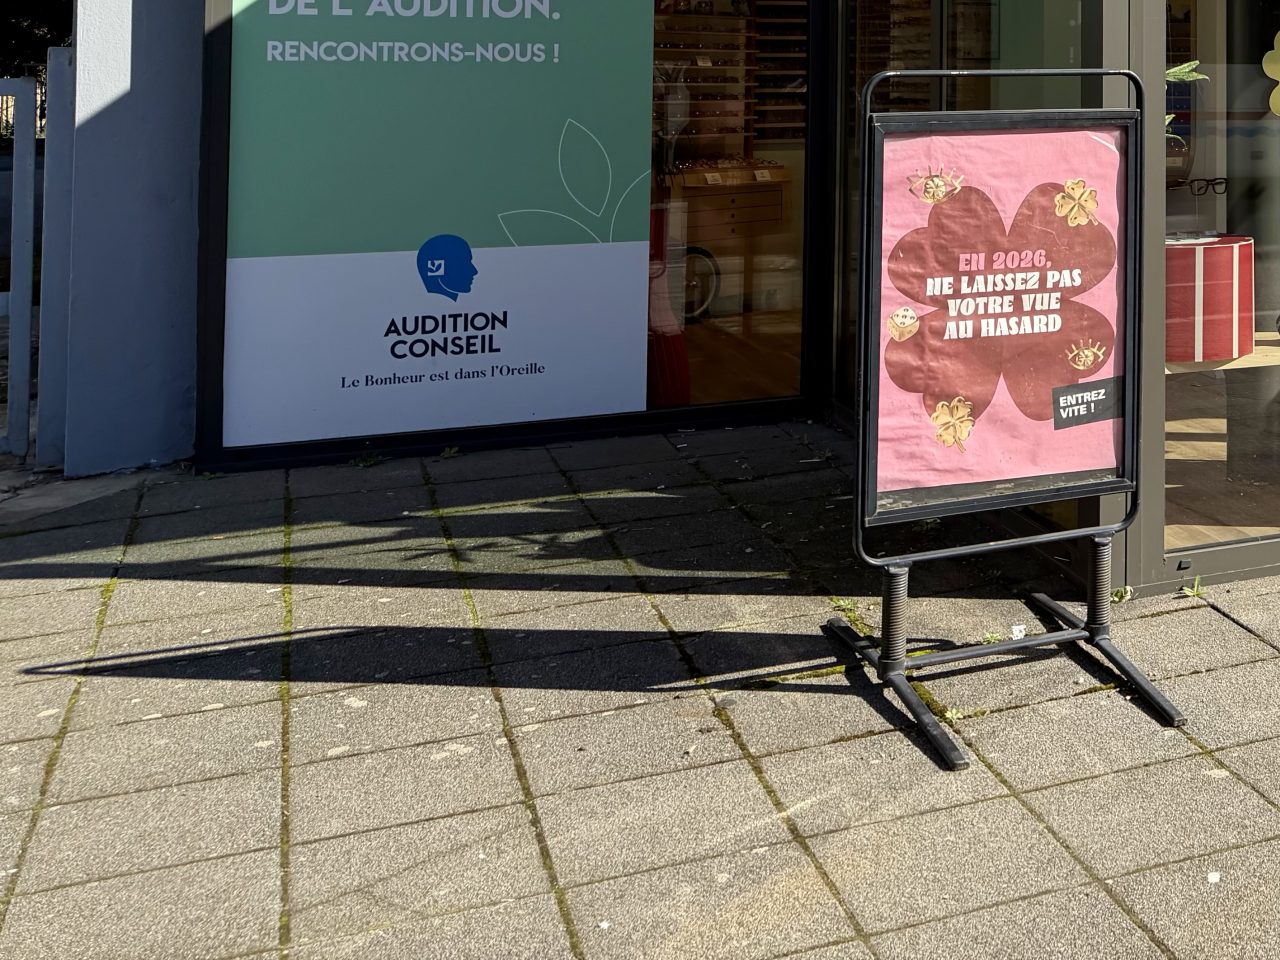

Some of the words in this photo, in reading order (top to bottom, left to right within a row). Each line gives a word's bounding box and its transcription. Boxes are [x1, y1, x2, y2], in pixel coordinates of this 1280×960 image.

[267, 40, 546, 63] RENCONTRONS-NOUS
[958, 252, 985, 272] EN
[992, 249, 1052, 270] 2026,
[925, 276, 954, 297] NE
[960, 271, 1040, 295] LAISSEZ
[1046, 268, 1082, 289] PAS
[947, 294, 1014, 317] VOTRE
[1021, 292, 1061, 312] VUE
[383, 311, 508, 337] AUDITION
[943, 319, 973, 340] AU
[980, 314, 1062, 337] HASARD
[390, 333, 501, 359] CONSEIL
[341, 376, 360, 389] Le
[364, 371, 426, 387] Bonheur
[429, 370, 450, 382] est
[454, 368, 487, 381] dans
[491, 362, 546, 378] l’Oreille
[1059, 389, 1106, 407] ENTREZ
[1059, 405, 1087, 419] VITE
